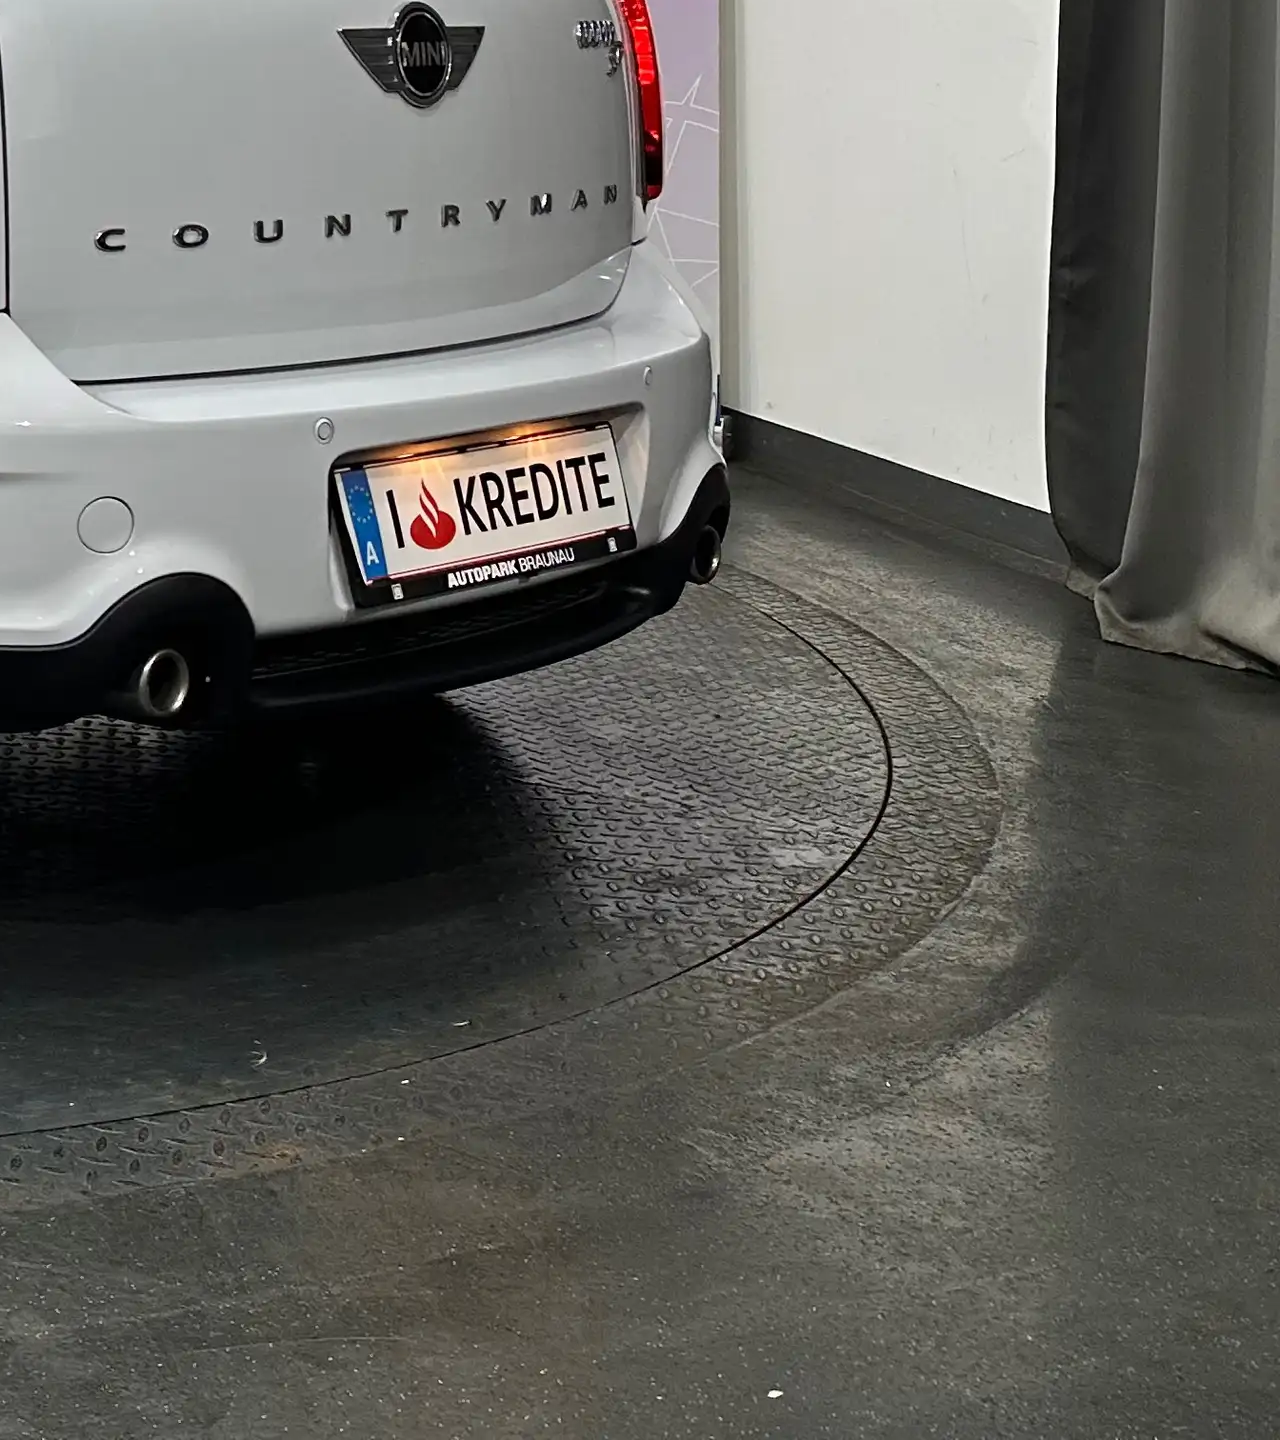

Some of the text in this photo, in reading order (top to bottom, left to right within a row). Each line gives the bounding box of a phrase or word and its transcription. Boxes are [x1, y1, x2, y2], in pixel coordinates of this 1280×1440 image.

[401, 40, 448, 68] MINI
[94, 183, 617, 252] COUNTRYMAN
[453, 452, 615, 536] KREDITE
[366, 541, 379, 566] A
[447, 547, 575, 588] AUTOPARK BRAUNAU
